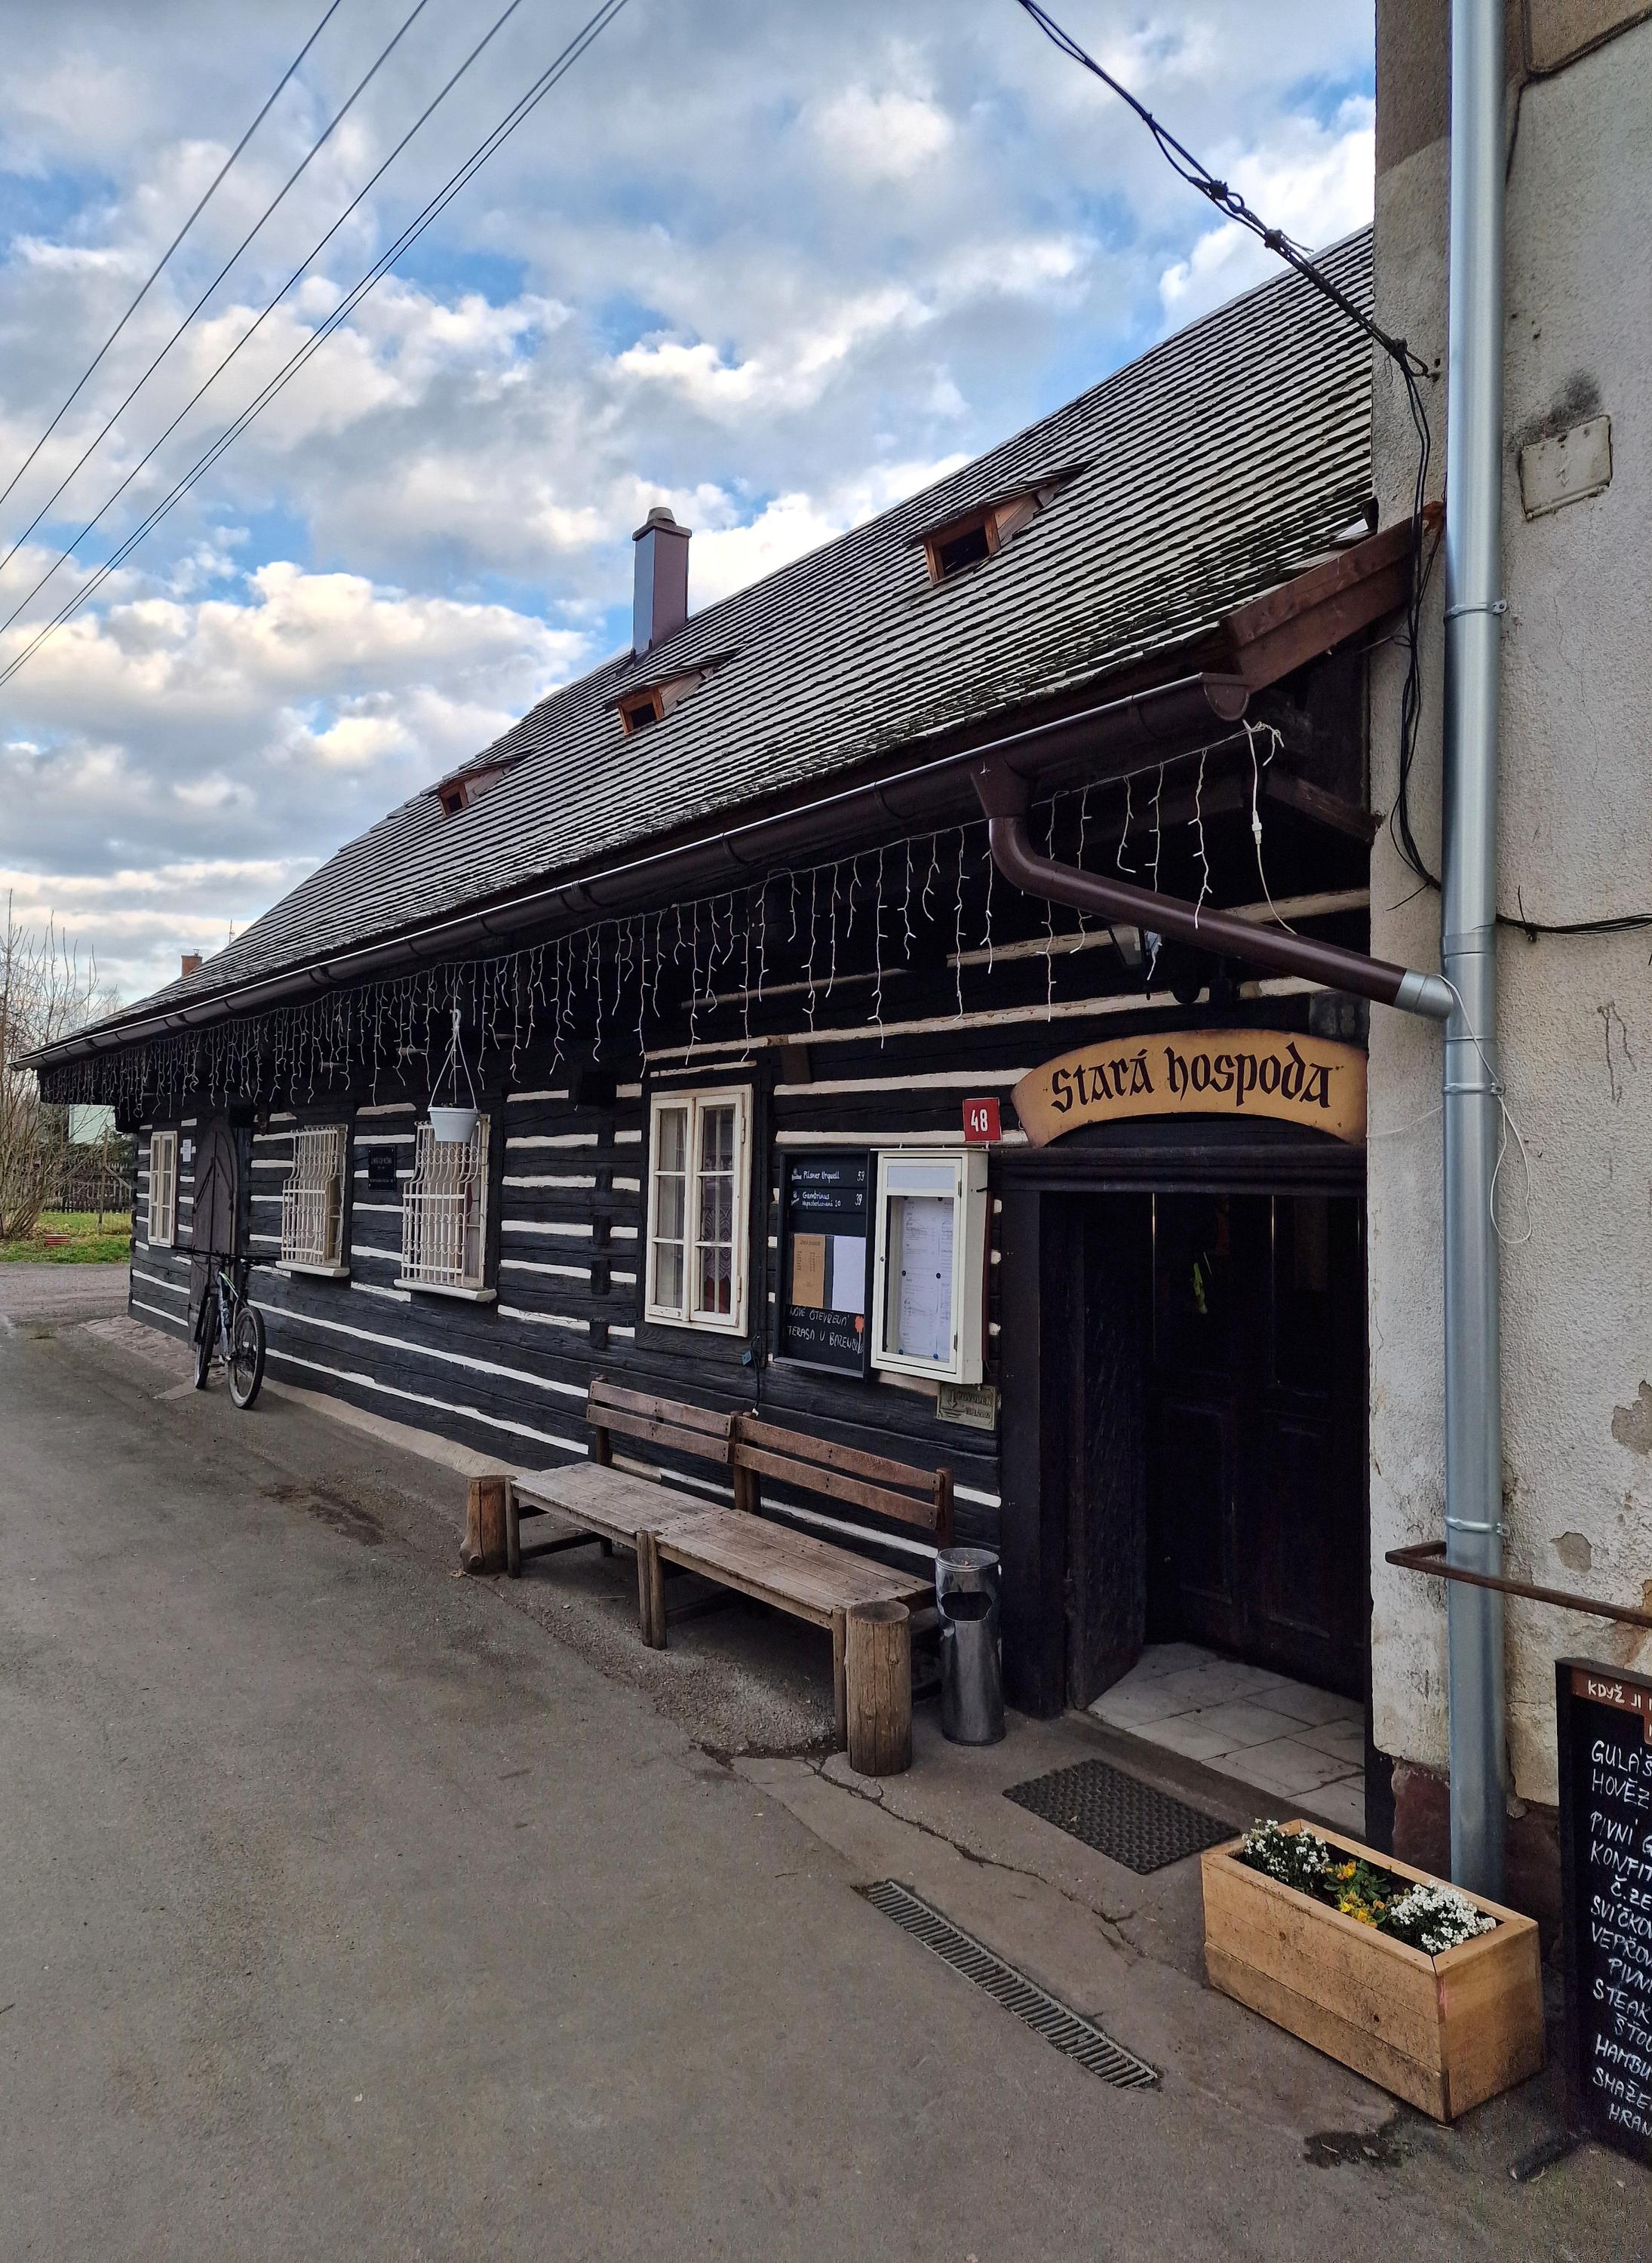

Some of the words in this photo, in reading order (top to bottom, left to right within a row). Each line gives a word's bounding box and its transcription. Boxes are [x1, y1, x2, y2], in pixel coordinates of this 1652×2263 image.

[1050, 1049, 1155, 1113] Stará
[1162, 1041, 1334, 1108] hospoda
[970, 1108, 988, 1132] 48
[803, 1171, 820, 1179] Pilsner
[821, 1171, 840, 1183] Urquell
[819, 1331, 825, 1341] U
[1588, 1679, 1625, 1703] KDYŽ
[1592, 1978, 1650, 2025] STEAK
[1592, 2067, 1652, 2113] SMAŽE
